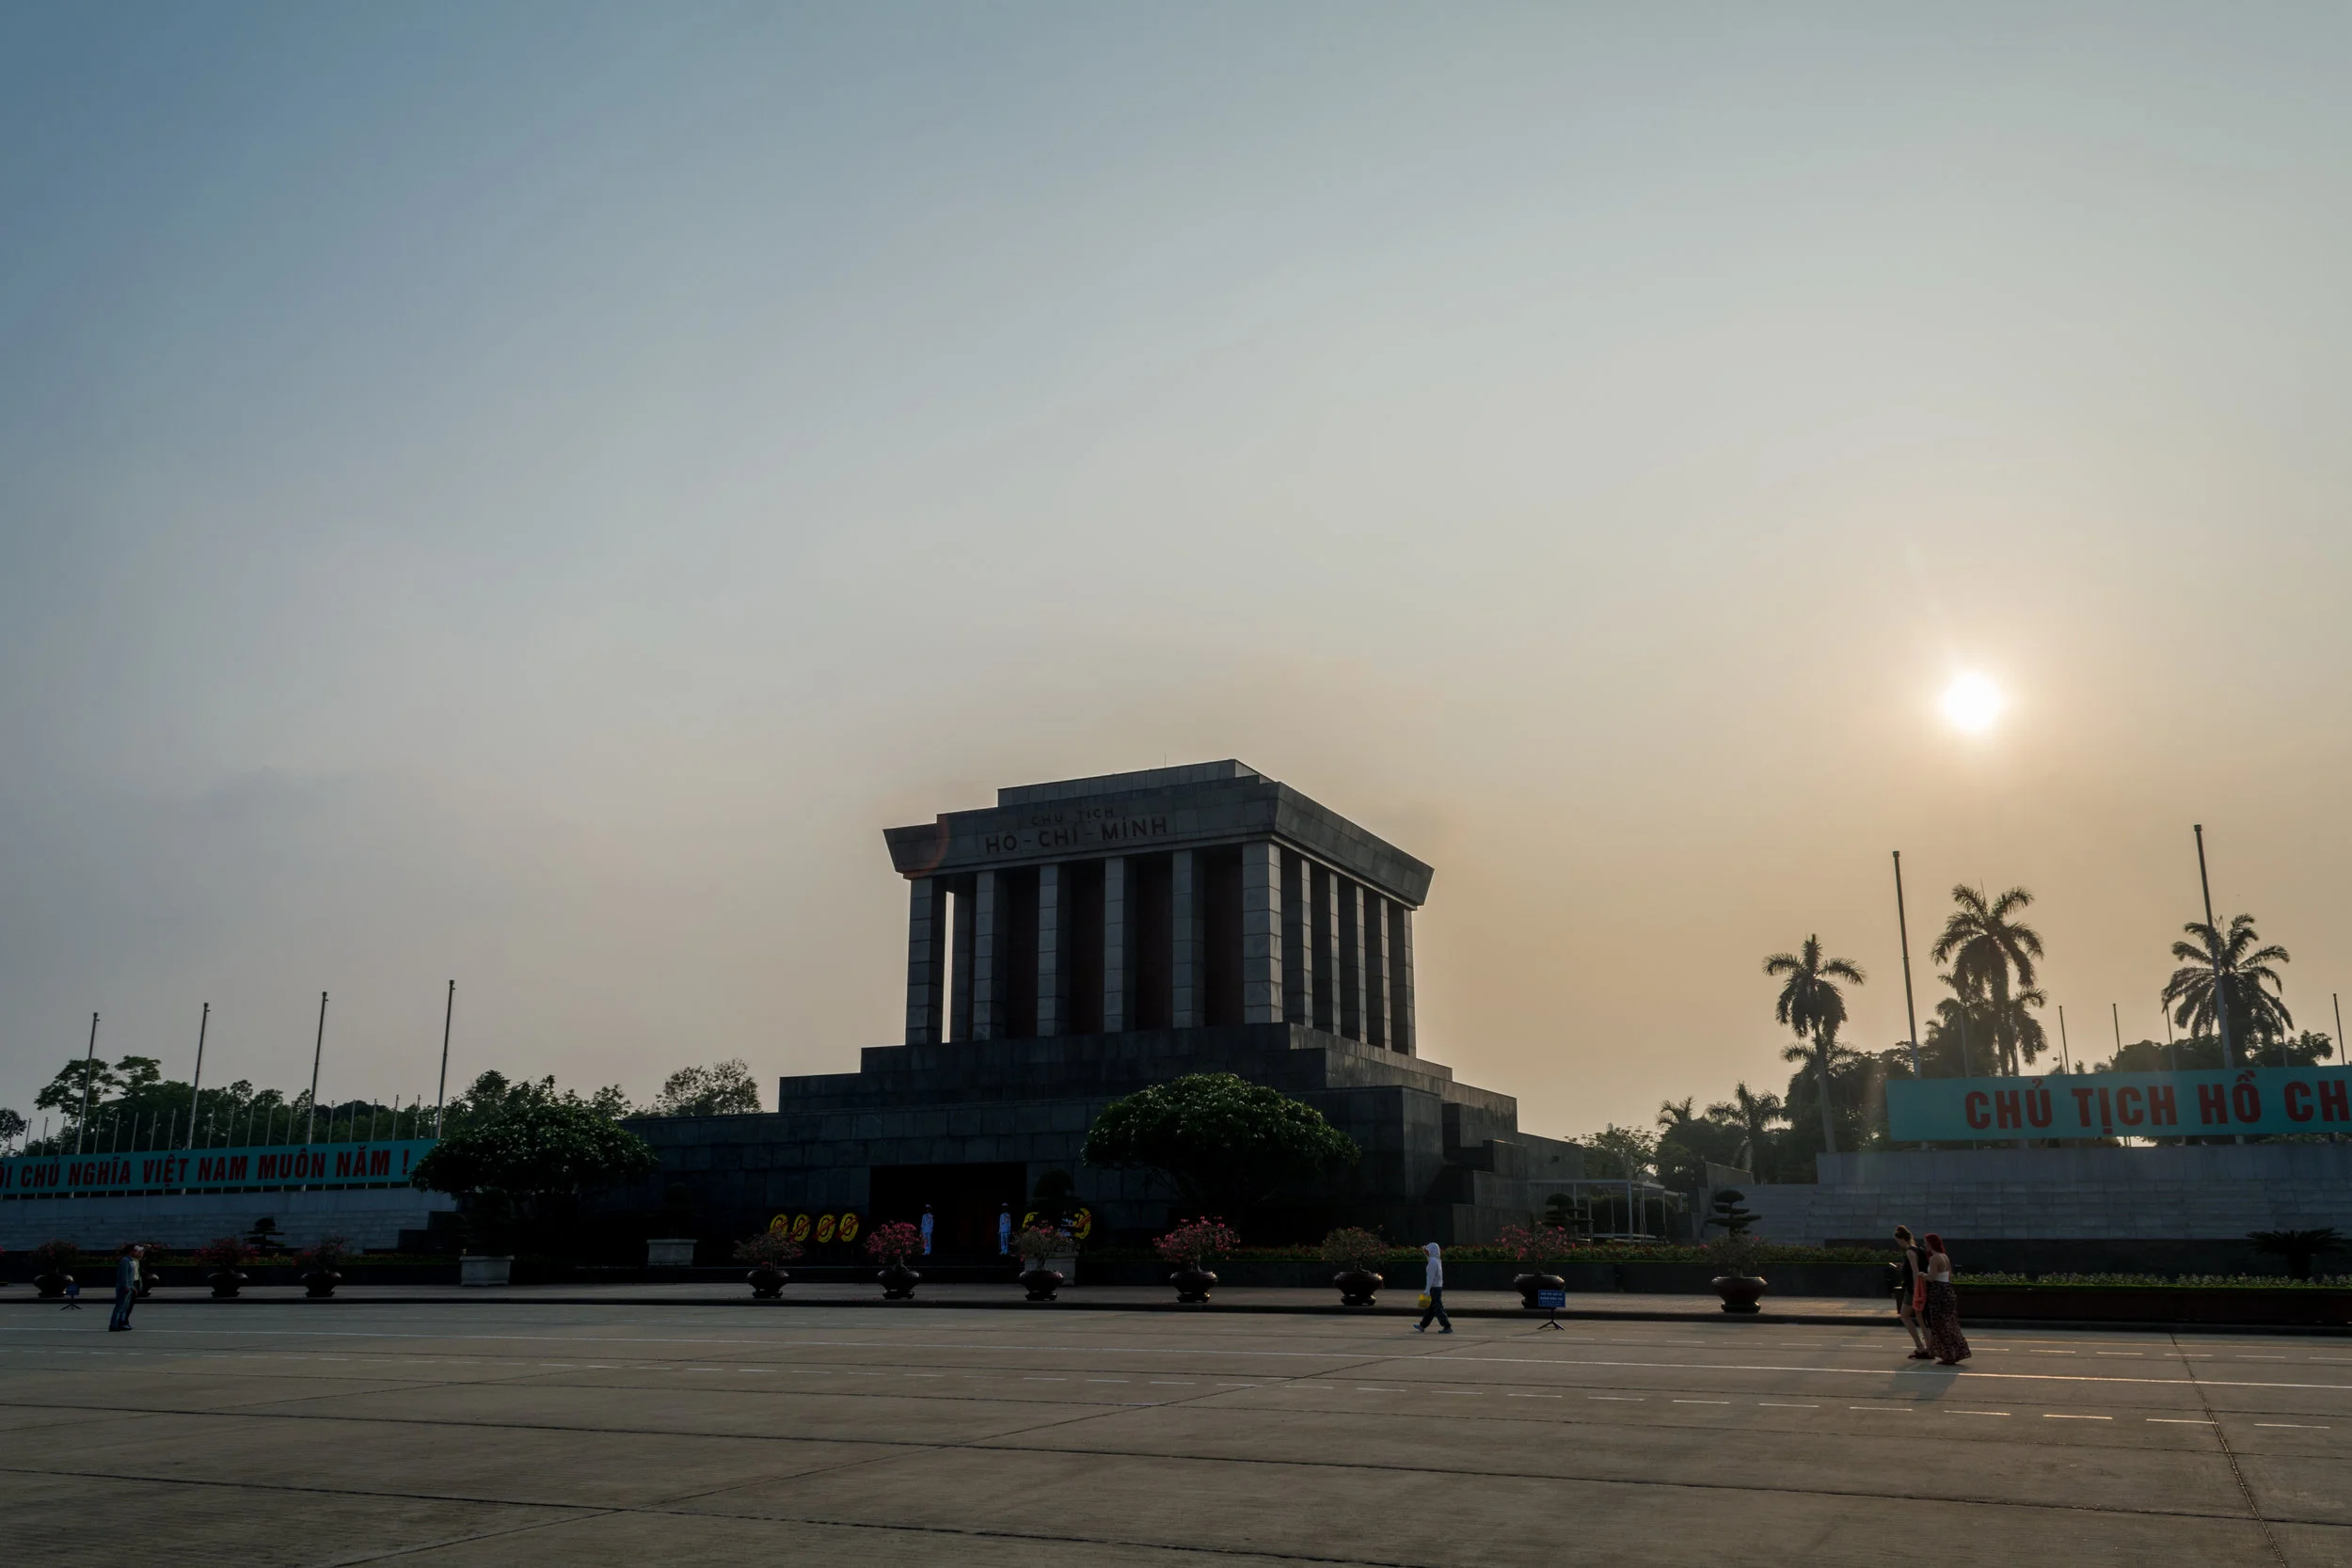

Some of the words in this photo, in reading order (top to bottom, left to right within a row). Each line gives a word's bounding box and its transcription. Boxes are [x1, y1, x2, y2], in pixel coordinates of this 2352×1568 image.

[1964, 1078, 2053, 1130] CHỦ
[2071, 1085, 2178, 1134] TỊCH
[2197, 1069, 2262, 1125] HỒ
[68, 1156, 131, 1187] NGHĨA
[143, 1153, 189, 1187] VIỆT
[198, 1155, 248, 1182] NAM
[257, 1148, 326, 1180] MUÔN
[335, 1145, 391, 1178] NĂM
